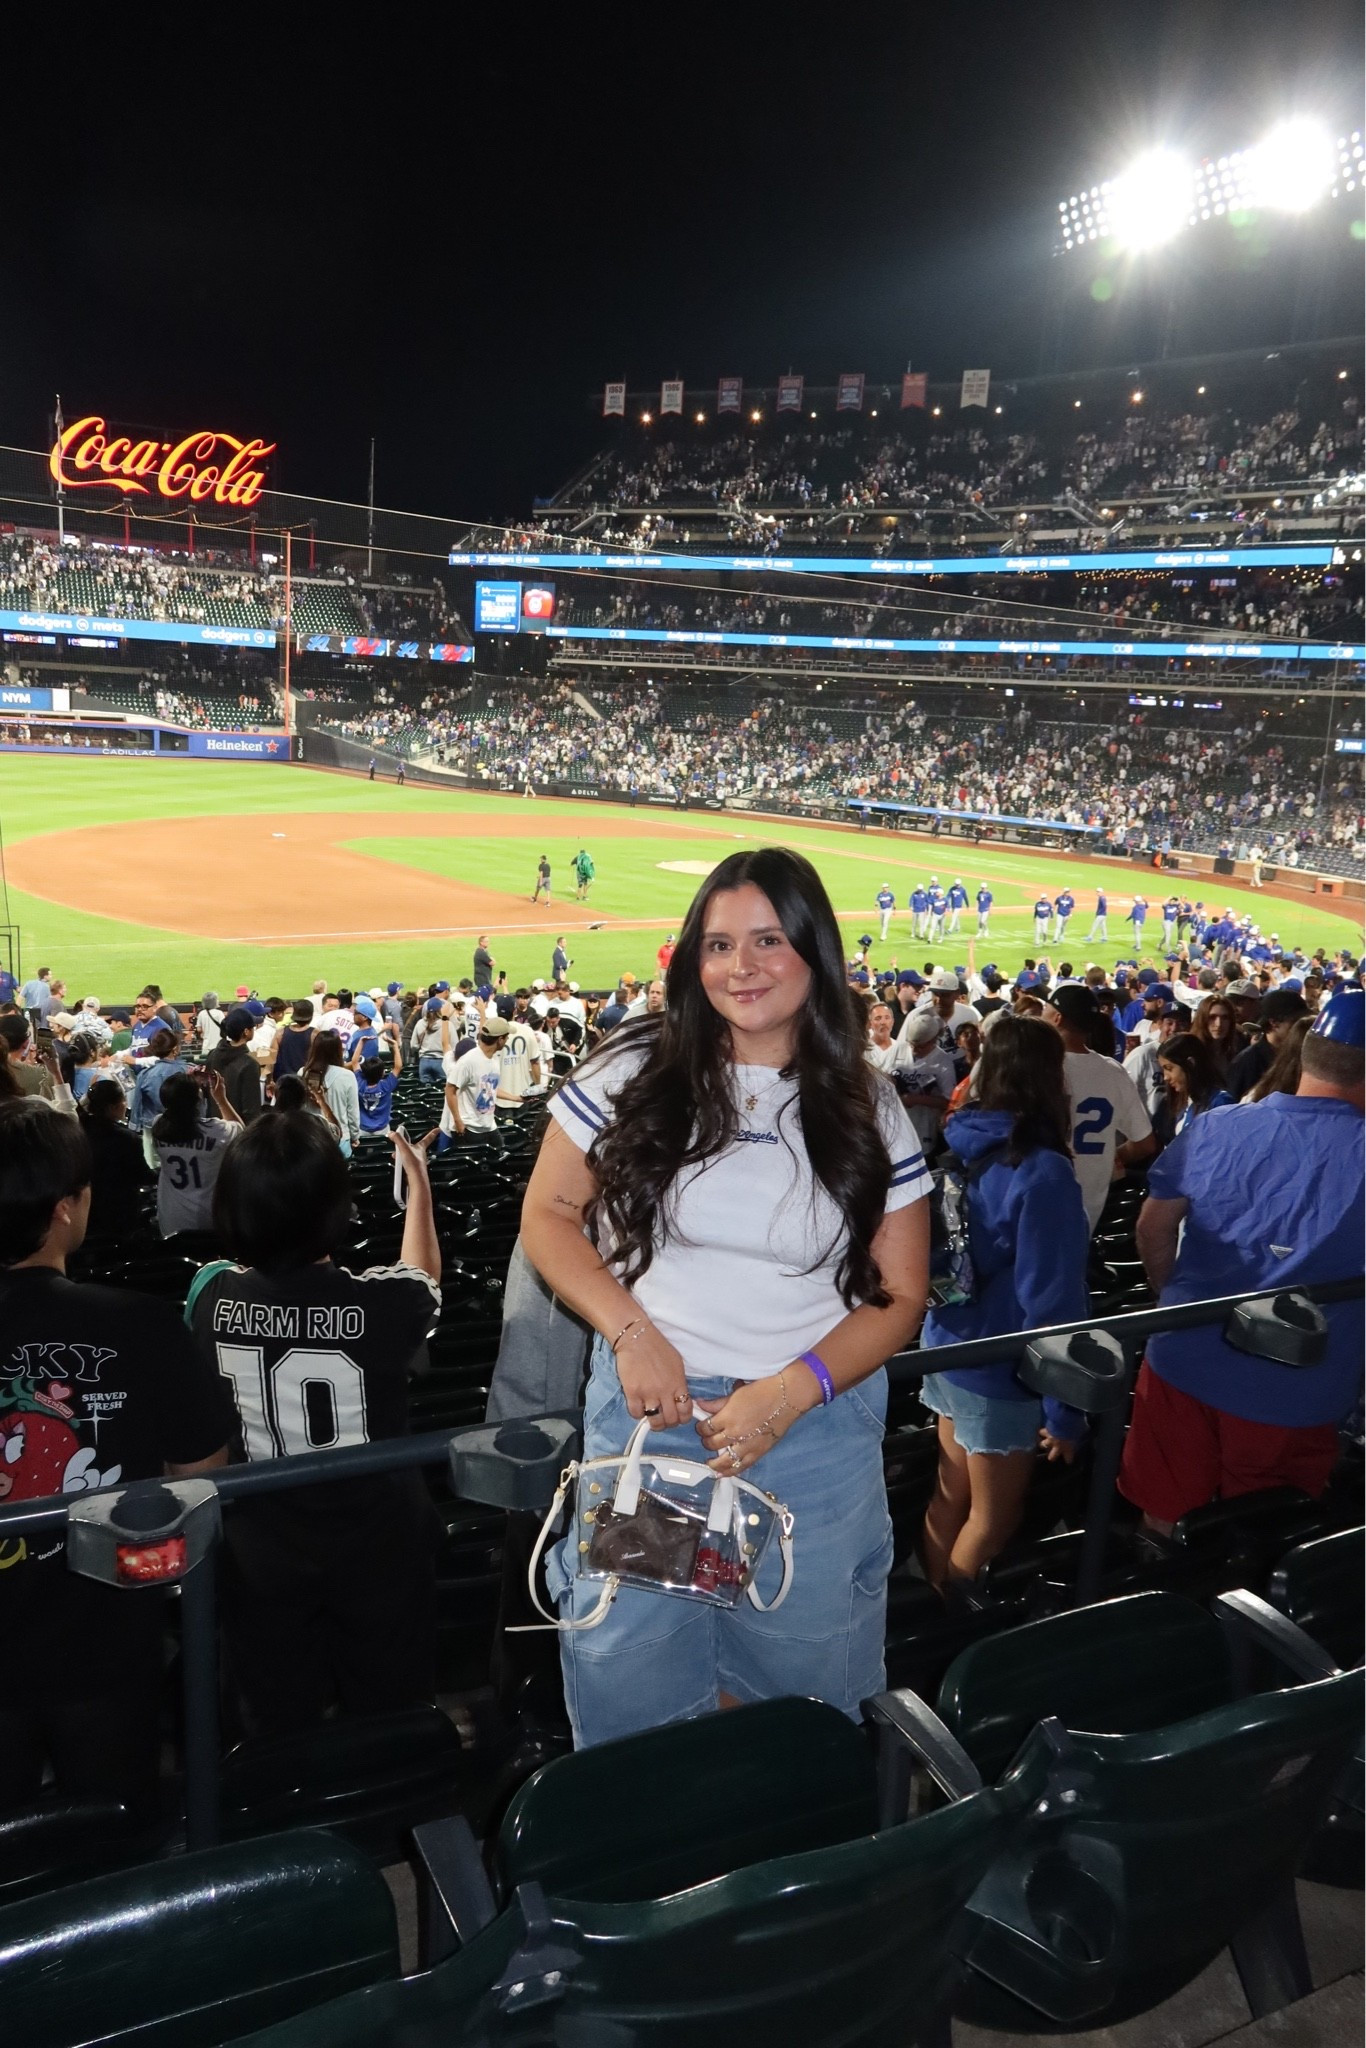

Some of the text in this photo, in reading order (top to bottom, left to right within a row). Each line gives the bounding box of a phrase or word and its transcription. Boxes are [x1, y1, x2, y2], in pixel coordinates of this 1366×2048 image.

[50, 416, 277, 505] Coca-Cola
[606, 557, 634, 566] dodgers
[871, 562, 903, 571] dodgers
[1006, 559, 1038, 569] dodgers
[1155, 555, 1229, 566] dodgers mets
[19, 614, 73, 630] dodgers
[92, 621, 125, 632] mets
[201, 628, 250, 642] dodgers
[667, 632, 694, 641] dodgers
[832, 638, 863, 648] dodgers
[999, 642, 1030, 652] dodgers
[1186, 644, 1223, 656] dodgers
[2, 692, 31, 704] NYM
[207, 739, 263, 752] Heineken
[335, 1016, 354, 1030] SOTO
[1073, 1096, 1114, 1155] 2
[736, 1129, 779, 1144] Angeles
[166, 1154, 202, 1190] 31
[213, 1298, 365, 1340] FARM RIO
[81, 1391, 128, 1402] SERVED
[215, 1340, 371, 1463] 10
[87, 1401, 123, 1411] FRESH
